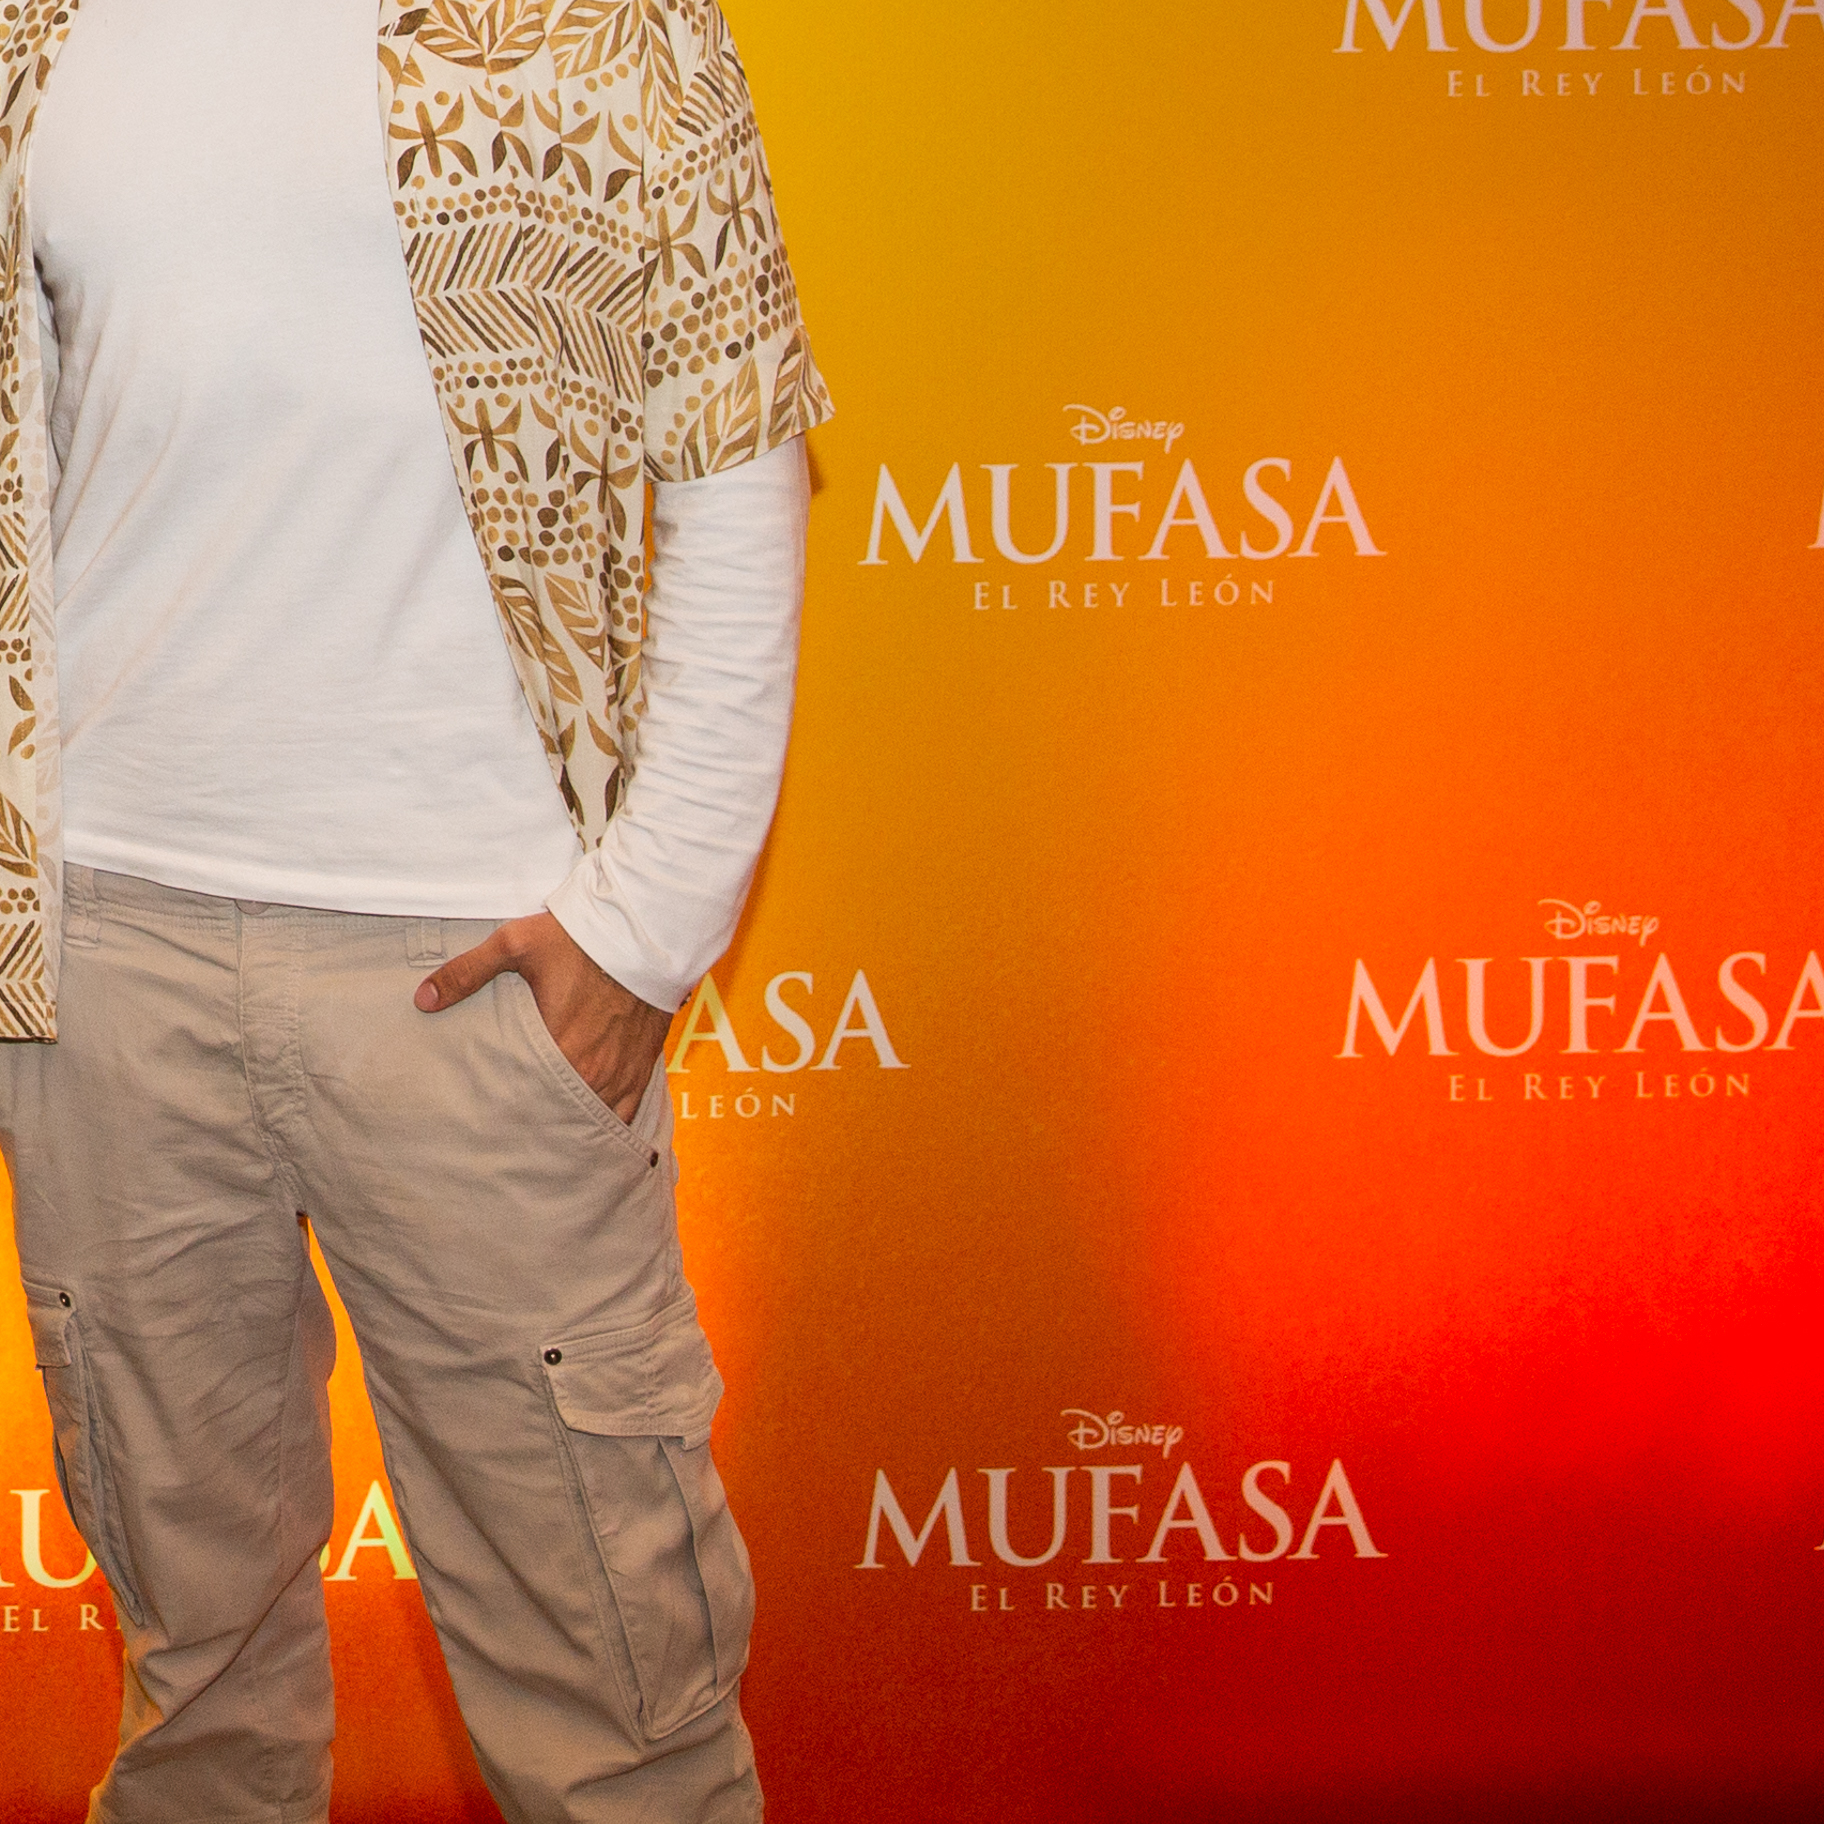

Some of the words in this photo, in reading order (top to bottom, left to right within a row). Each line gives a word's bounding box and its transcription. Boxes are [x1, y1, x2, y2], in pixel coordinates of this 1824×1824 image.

[859, 457, 1385, 565] MUFASA
[665, 968, 911, 1074] ASA
[855, 1458, 1388, 1570] MUFASA
